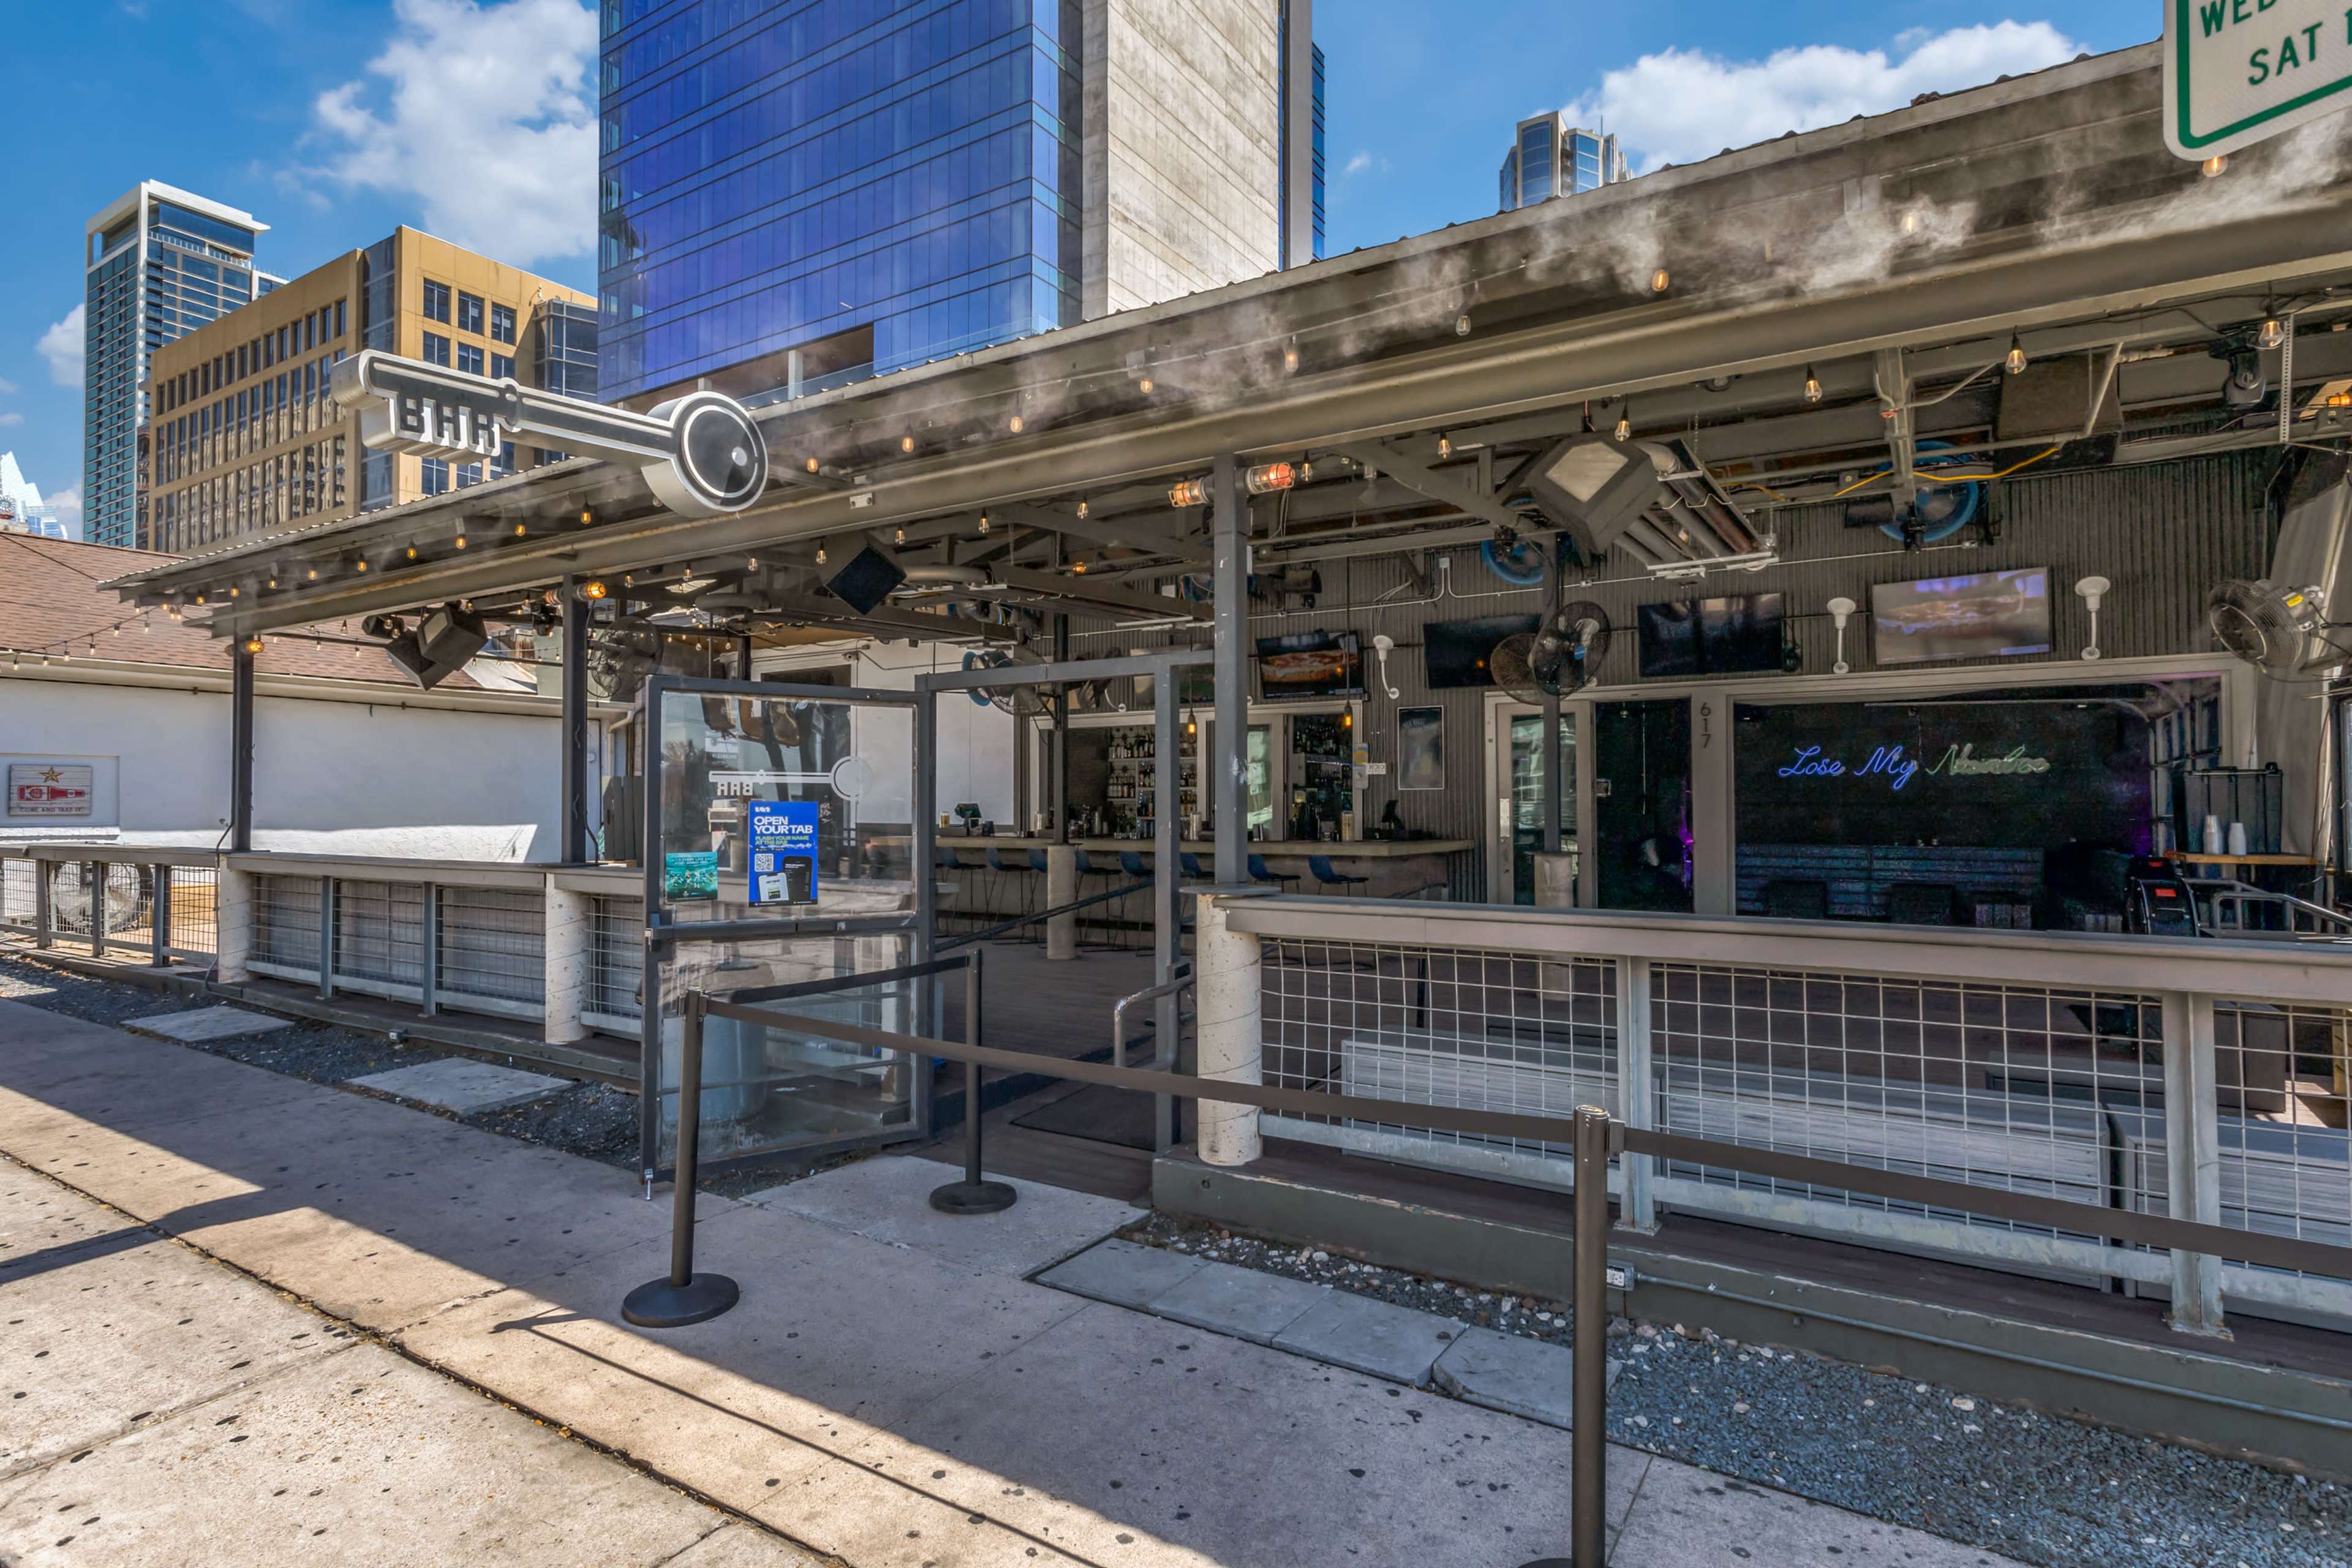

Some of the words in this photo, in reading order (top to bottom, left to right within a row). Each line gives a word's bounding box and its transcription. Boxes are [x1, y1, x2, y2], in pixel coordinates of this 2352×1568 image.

[2248, 21, 2323, 85] SAT
[399, 393, 496, 450] BAR
[1700, 702, 1711, 748] 617
[1779, 746, 1844, 776] Lose
[1854, 745, 1916, 790] My
[754, 816, 788, 825] OPEN
[754, 825, 789, 834] YOUR
[790, 825, 813, 834] TAB
